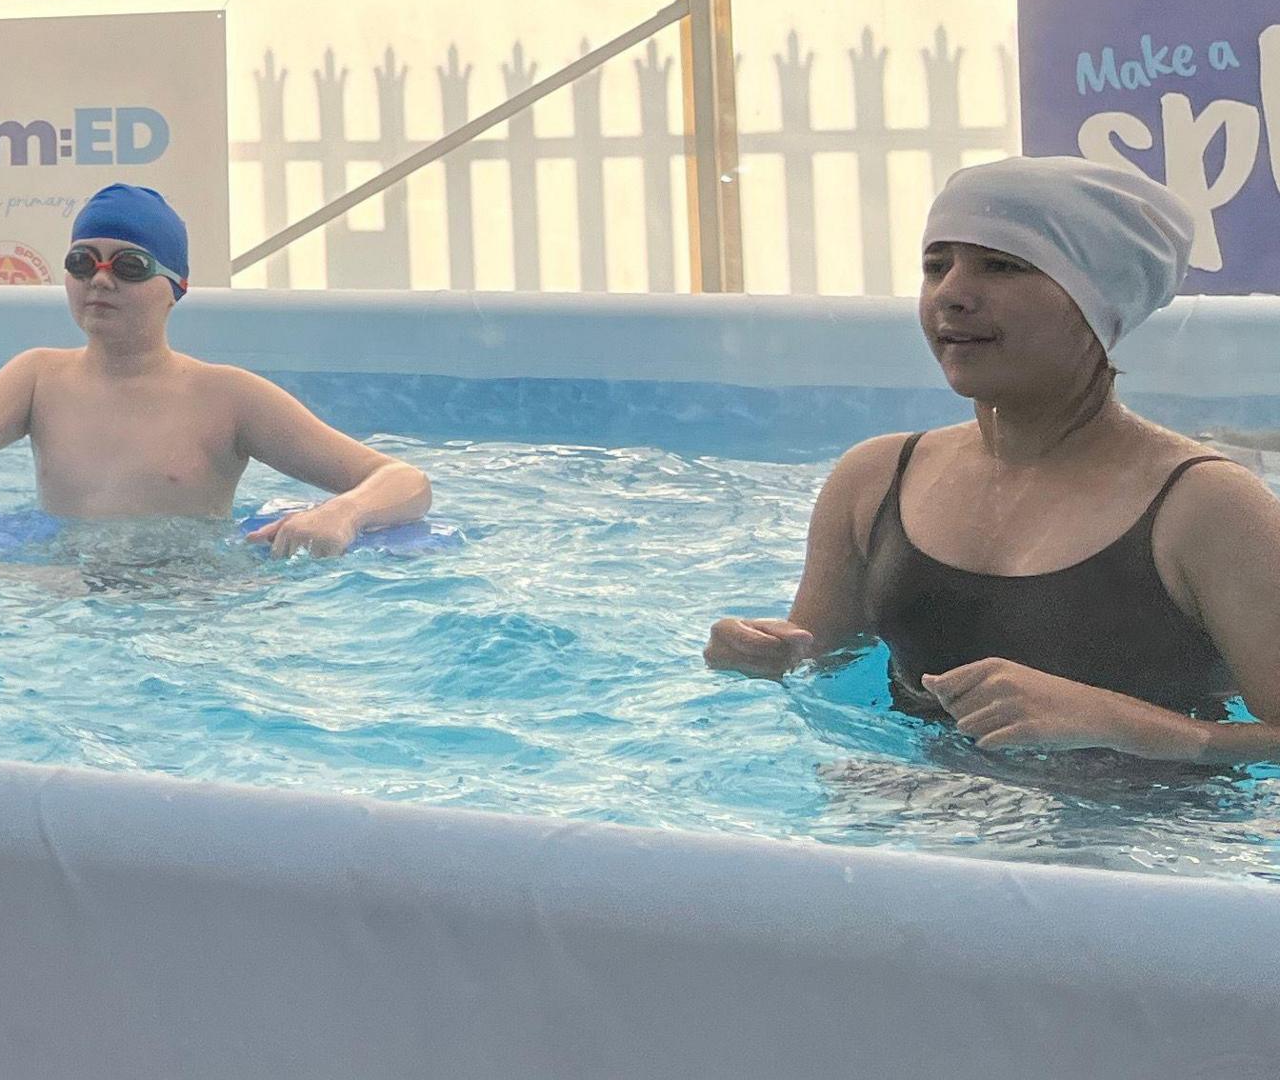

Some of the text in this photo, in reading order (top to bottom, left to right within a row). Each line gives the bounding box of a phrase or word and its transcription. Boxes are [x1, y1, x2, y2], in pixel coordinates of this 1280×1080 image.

[1076, 34, 1241, 95] Make a
[5, 196, 77, 218] primary
